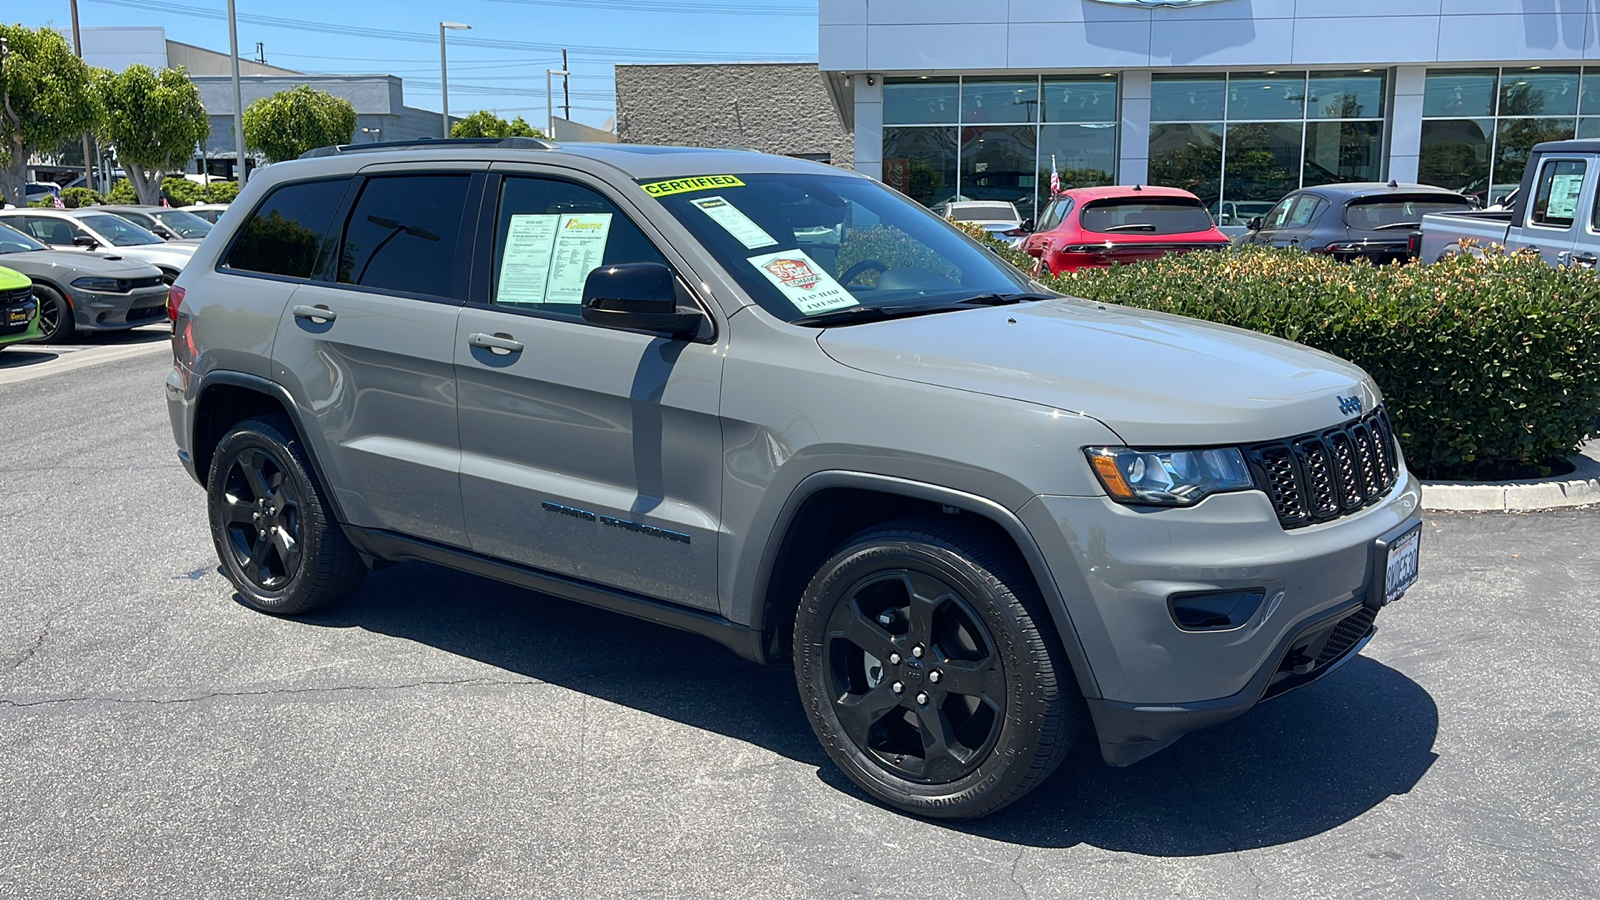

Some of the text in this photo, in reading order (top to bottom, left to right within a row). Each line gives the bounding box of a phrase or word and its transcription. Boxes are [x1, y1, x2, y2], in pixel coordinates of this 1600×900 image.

[645, 176, 737, 194] CERTIFIED
[771, 264, 813, 280] 3 DAY
[1336, 395, 1362, 416] Jeep
[925, 772, 998, 808] DESTINATION
